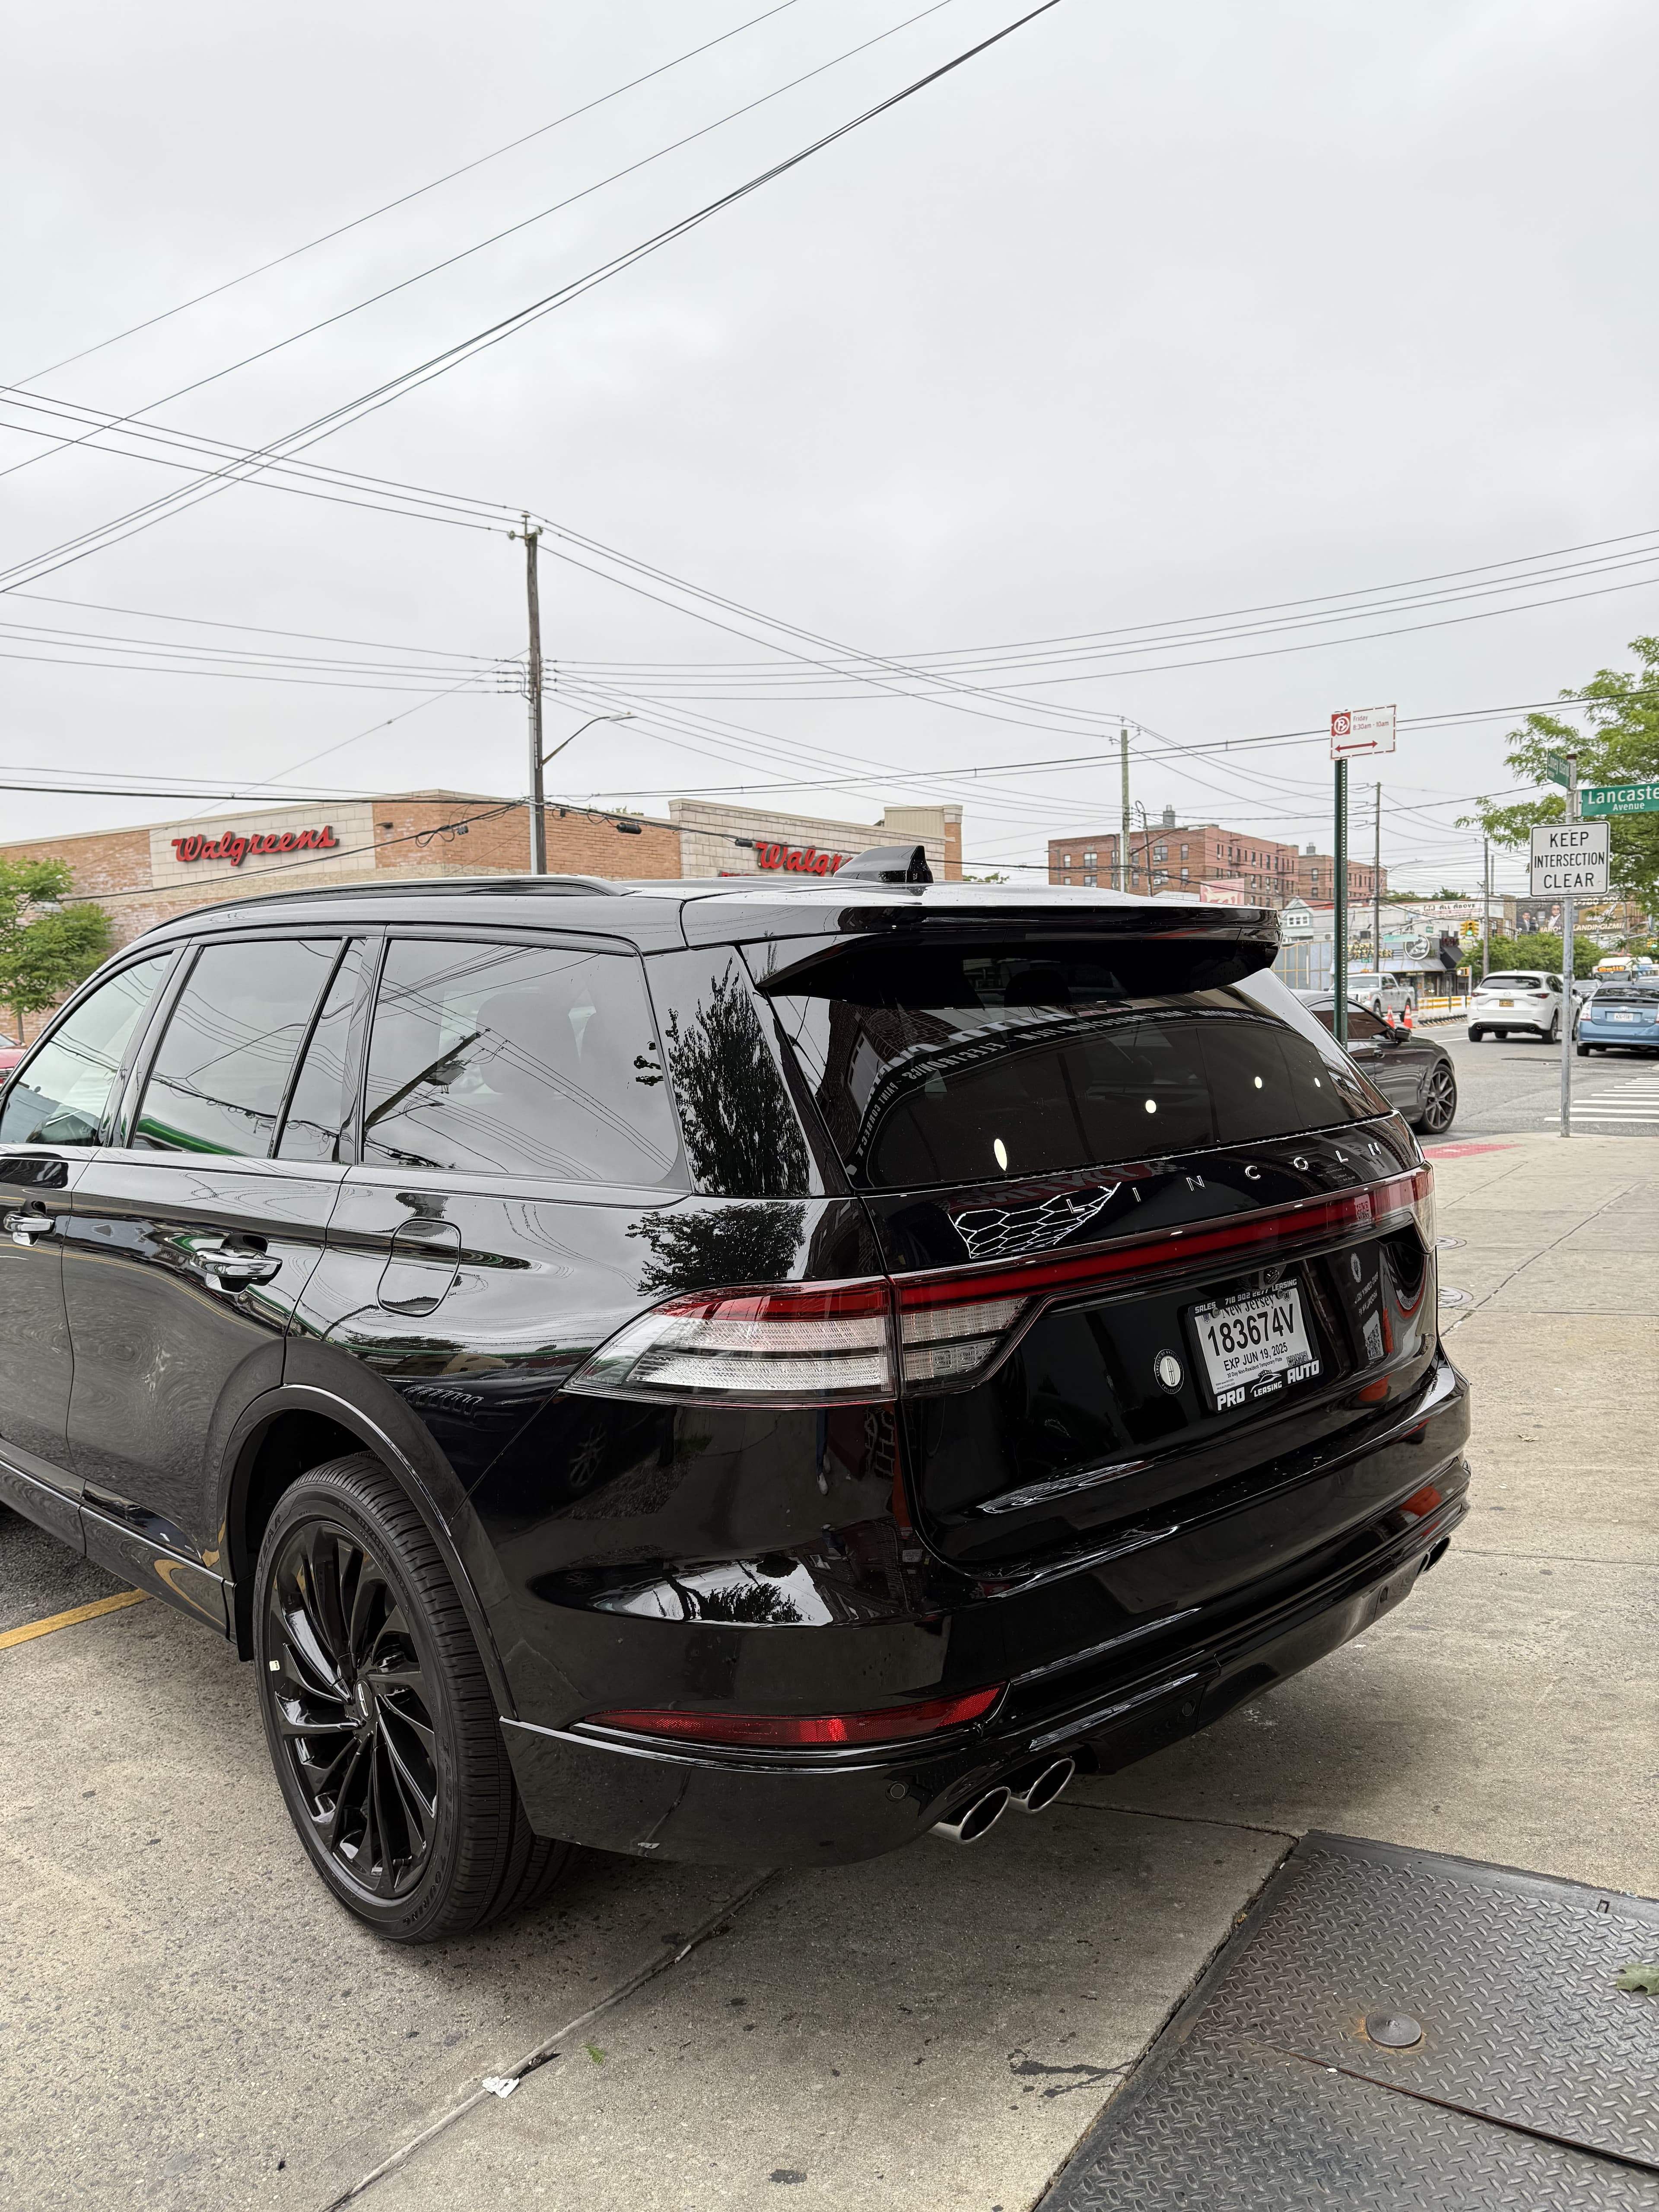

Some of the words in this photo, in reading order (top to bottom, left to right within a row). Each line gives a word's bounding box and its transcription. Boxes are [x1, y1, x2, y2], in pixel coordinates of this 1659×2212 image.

[1613, 802, 1645, 811] Avenue
[171, 826, 336, 866] Walgreens
[1550, 832, 1589, 848] KEEP
[1535, 852, 1605, 868] INTERSECTION
[1544, 872, 1594, 889] CLEAR
[1066, 1142, 1380, 1214] LINCOLN
[1195, 1301, 1216, 1314] SALES
[1225, 1295, 1236, 1305] 718
[1237, 1292, 1251, 1302] 902
[1271, 1279, 1297, 1292] LEASING
[1222, 1304, 1243, 1318] New
[1245, 1294, 1275, 1313] Jersey
[1208, 1303, 1294, 1356] 183674V
[1224, 1357, 1240, 1371] EXP
[1243, 1351, 1259, 1366] JUN
[1260, 1348, 1271, 1359] 19,
[1271, 1342, 1288, 1356] 2025
[1238, 1365, 1259, 1374] Non-Resident
[1259, 1360, 1275, 1368] Temporary
[1217, 1386, 1245, 1411] PRO
[1254, 1381, 1282, 1397] LEASING
[1287, 1360, 1319, 1384] AUTO
[403, 1854, 446, 1930] TOURING
